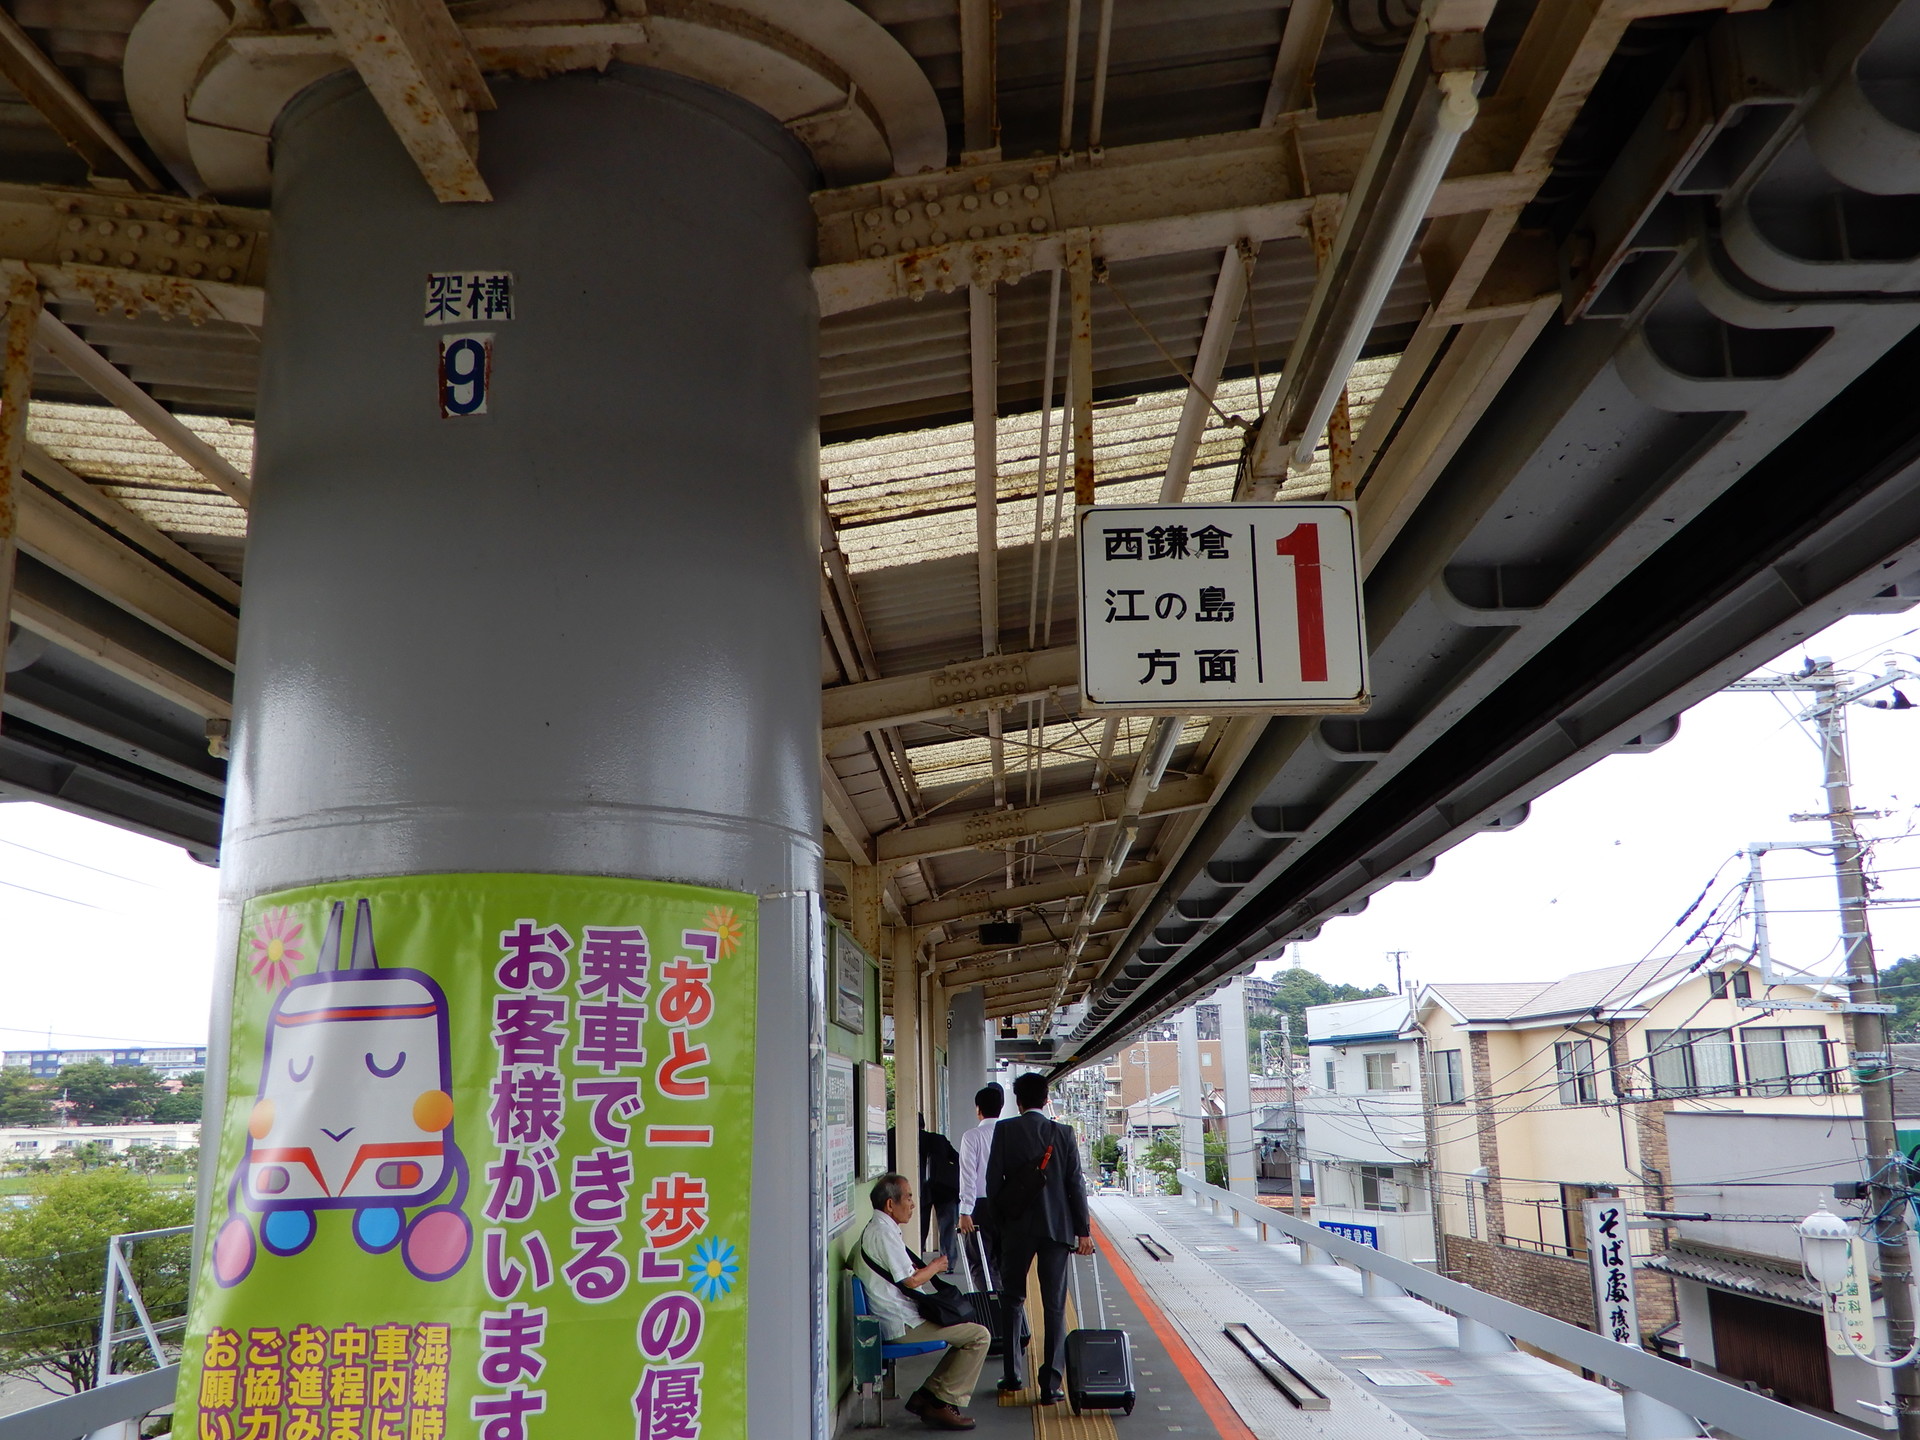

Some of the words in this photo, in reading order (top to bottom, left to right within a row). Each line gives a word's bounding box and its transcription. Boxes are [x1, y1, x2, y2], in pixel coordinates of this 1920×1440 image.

[425, 275, 511, 320] 架構
[445, 339, 485, 414] 9
[1103, 524, 1232, 561] 西鎌倉
[1105, 586, 1235, 623] 江の島
[1276, 523, 1327, 682] 1
[1138, 649, 1239, 685] 方面
[565, 930, 648, 1299] 乗車できる
[475, 924, 569, 1440] お客様がいます
[200, 1329, 238, 1440] お願い
[242, 1329, 284, 1440] ご協力
[286, 1327, 326, 1440] お進み
[330, 1326, 366, 1440] 中程ま
[372, 1326, 409, 1440] 車内に
[411, 1326, 448, 1440] 混雑時
